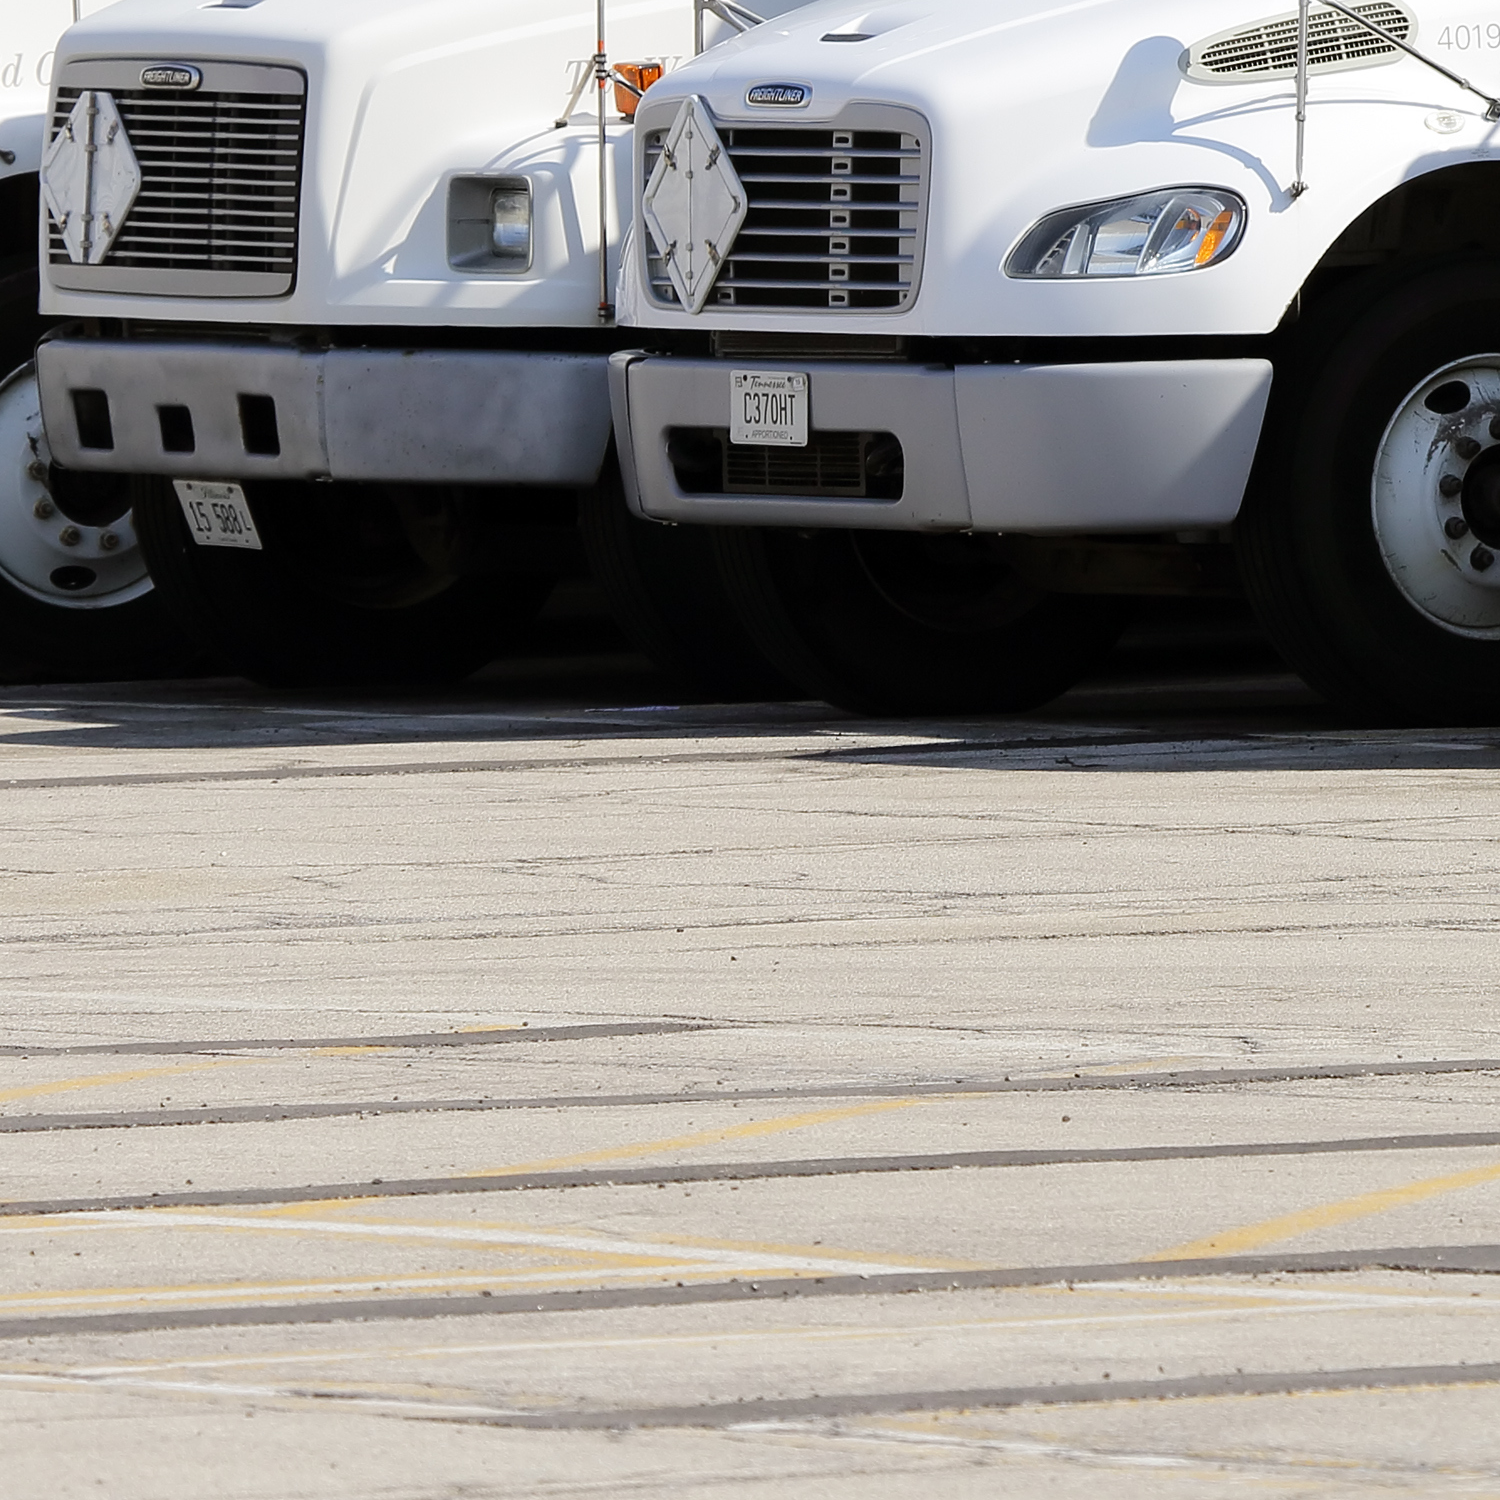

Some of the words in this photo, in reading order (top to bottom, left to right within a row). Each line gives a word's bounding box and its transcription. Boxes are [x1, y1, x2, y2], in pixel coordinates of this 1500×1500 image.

[749, 88, 803, 102] FREIGHTLINER
[750, 375, 787, 390] Tennessee
[743, 392, 796, 426] C370HT
[188, 501, 213, 533] 15
